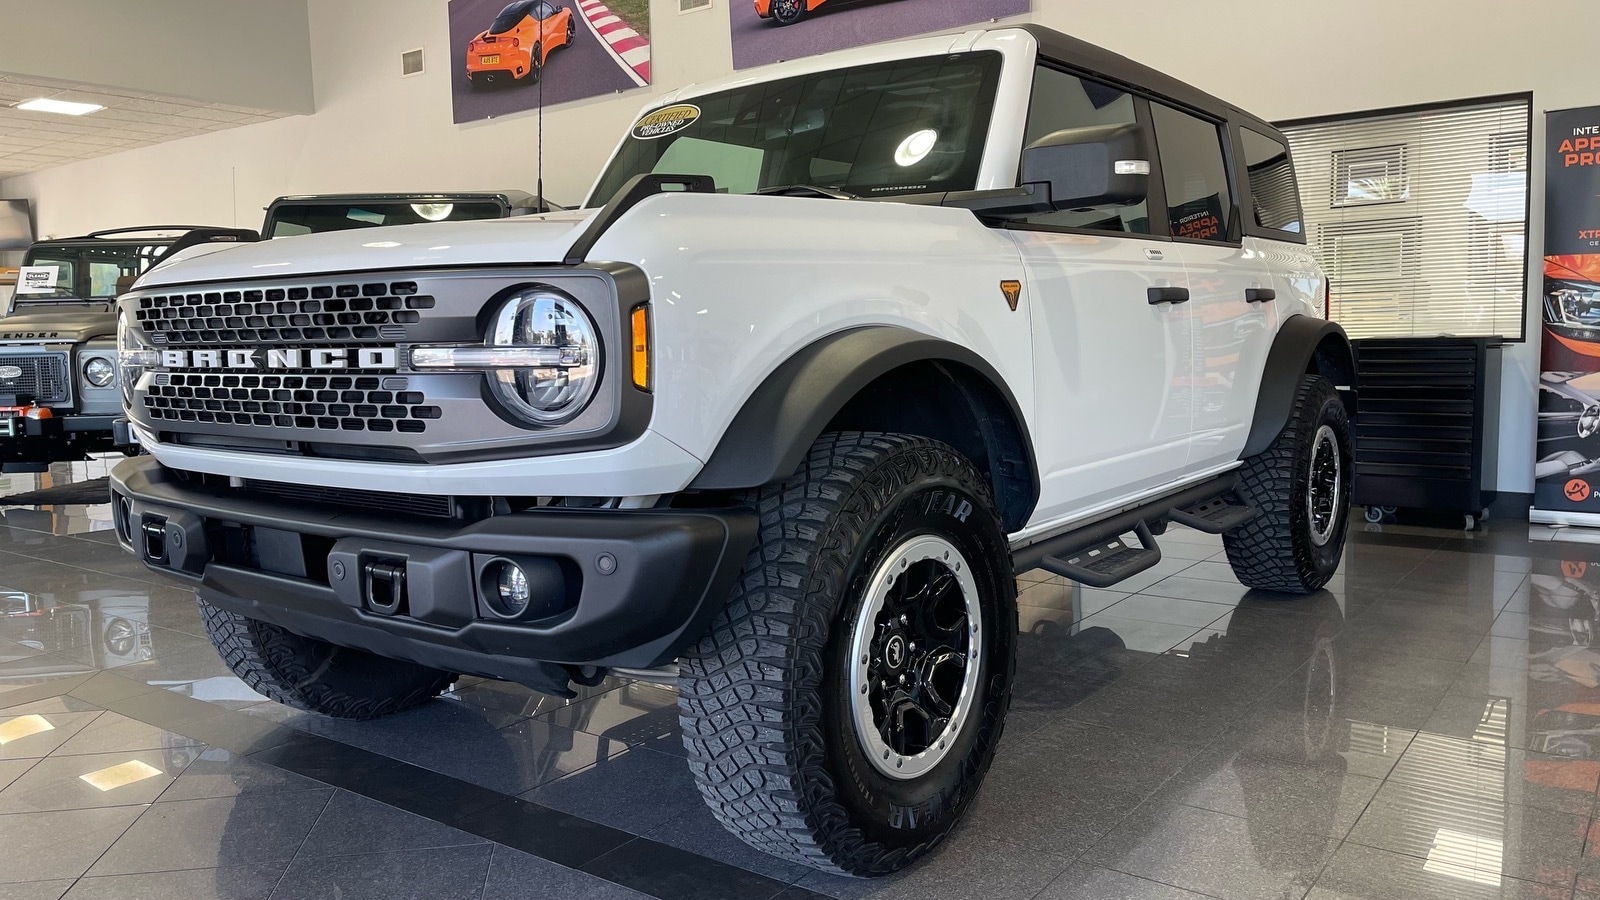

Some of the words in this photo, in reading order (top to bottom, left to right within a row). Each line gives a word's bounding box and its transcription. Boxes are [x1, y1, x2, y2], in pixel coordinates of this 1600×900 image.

[645, 110, 692, 124] CERTIFIED
[1573, 126, 1600, 136] INTE
[162, 347, 396, 369] BRONCO
